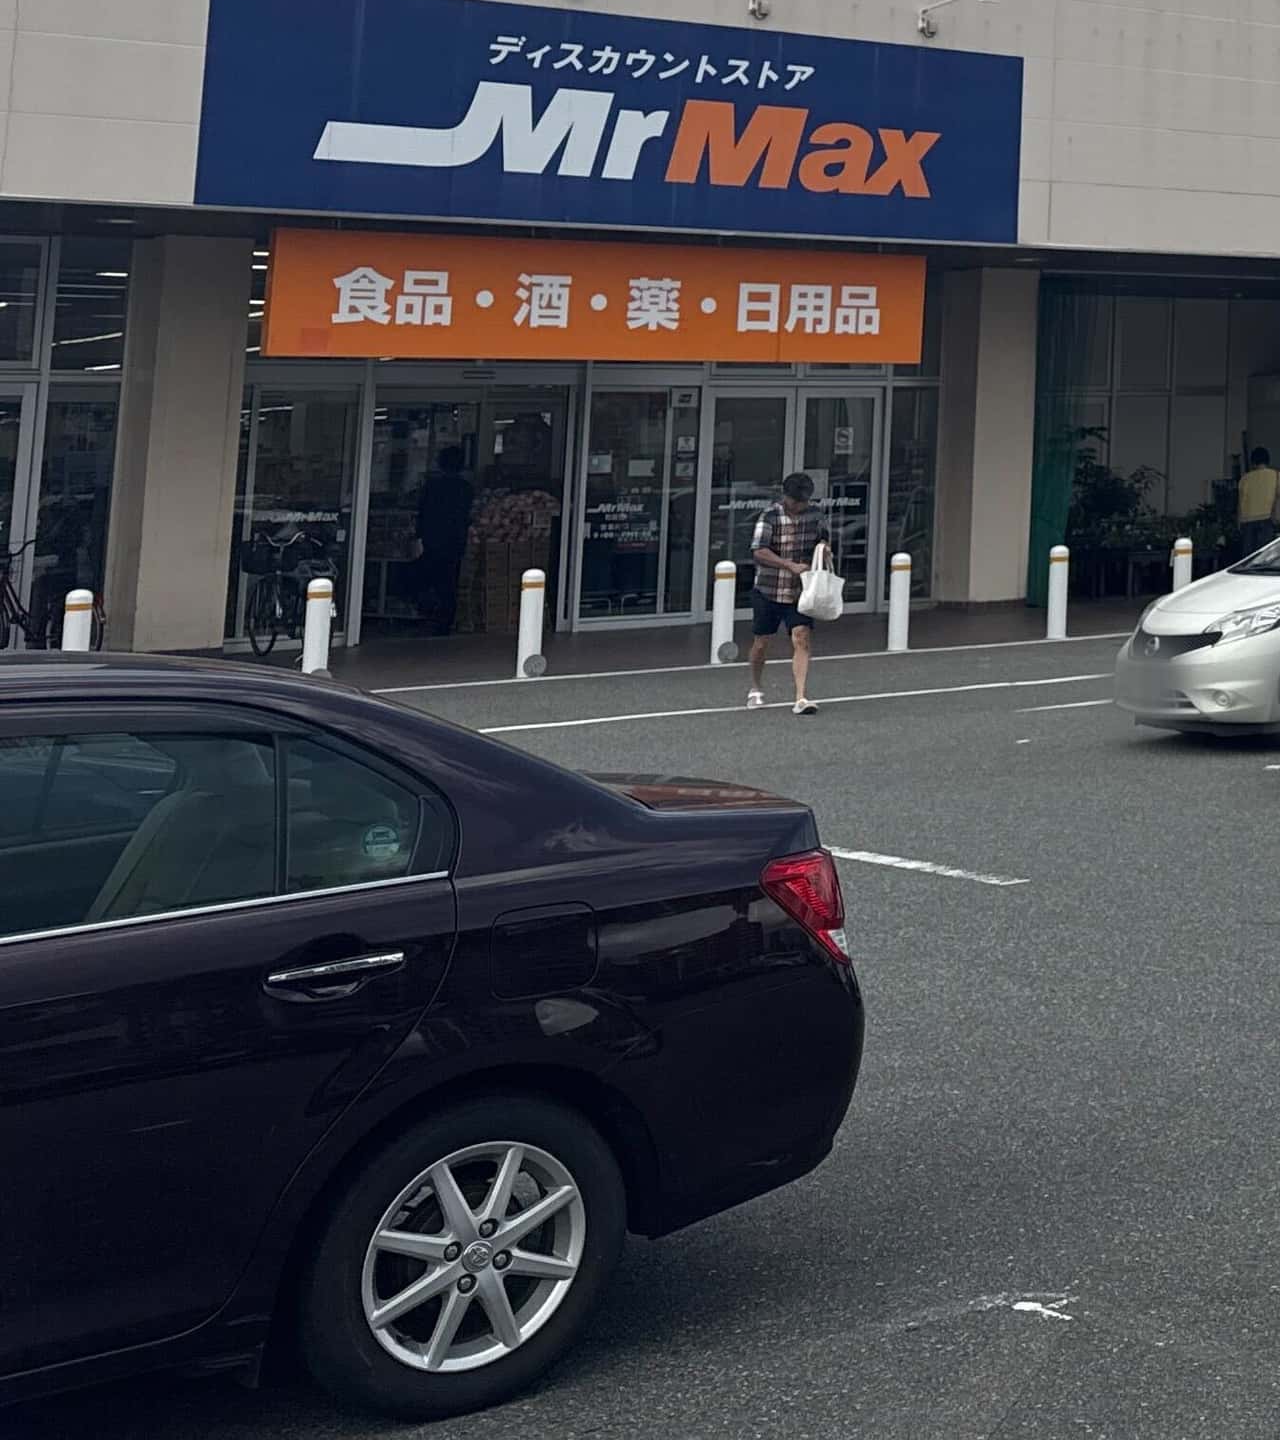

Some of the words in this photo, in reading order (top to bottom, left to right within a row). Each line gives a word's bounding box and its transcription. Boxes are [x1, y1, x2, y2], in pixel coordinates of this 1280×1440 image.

[488, 35, 814, 91] ディスカウントストア
[312, 80, 942, 199] MrMax
[330, 266, 880, 335] 食品・酒・薬・日用品
